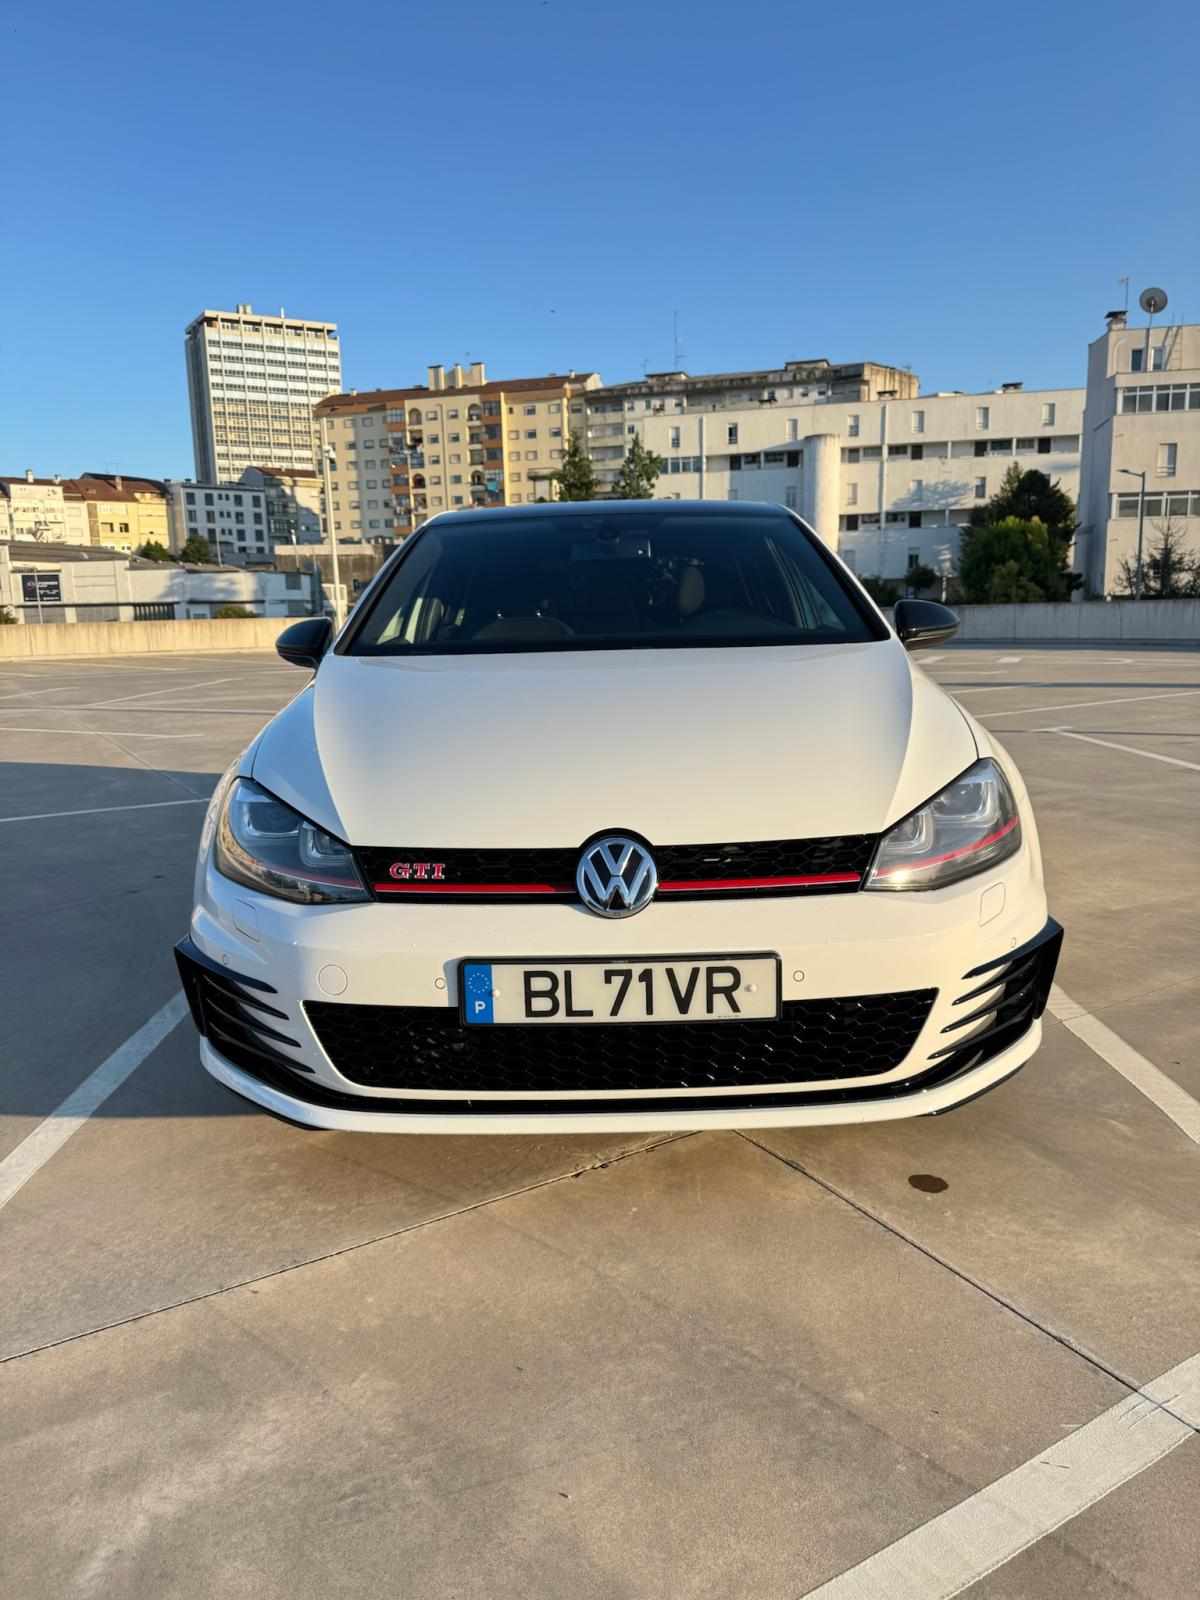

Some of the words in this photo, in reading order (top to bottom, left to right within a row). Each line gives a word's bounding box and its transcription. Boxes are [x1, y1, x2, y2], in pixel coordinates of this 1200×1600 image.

[389, 863, 446, 879] GTI
[579, 840, 655, 913] VW
[475, 1001, 486, 1014] P
